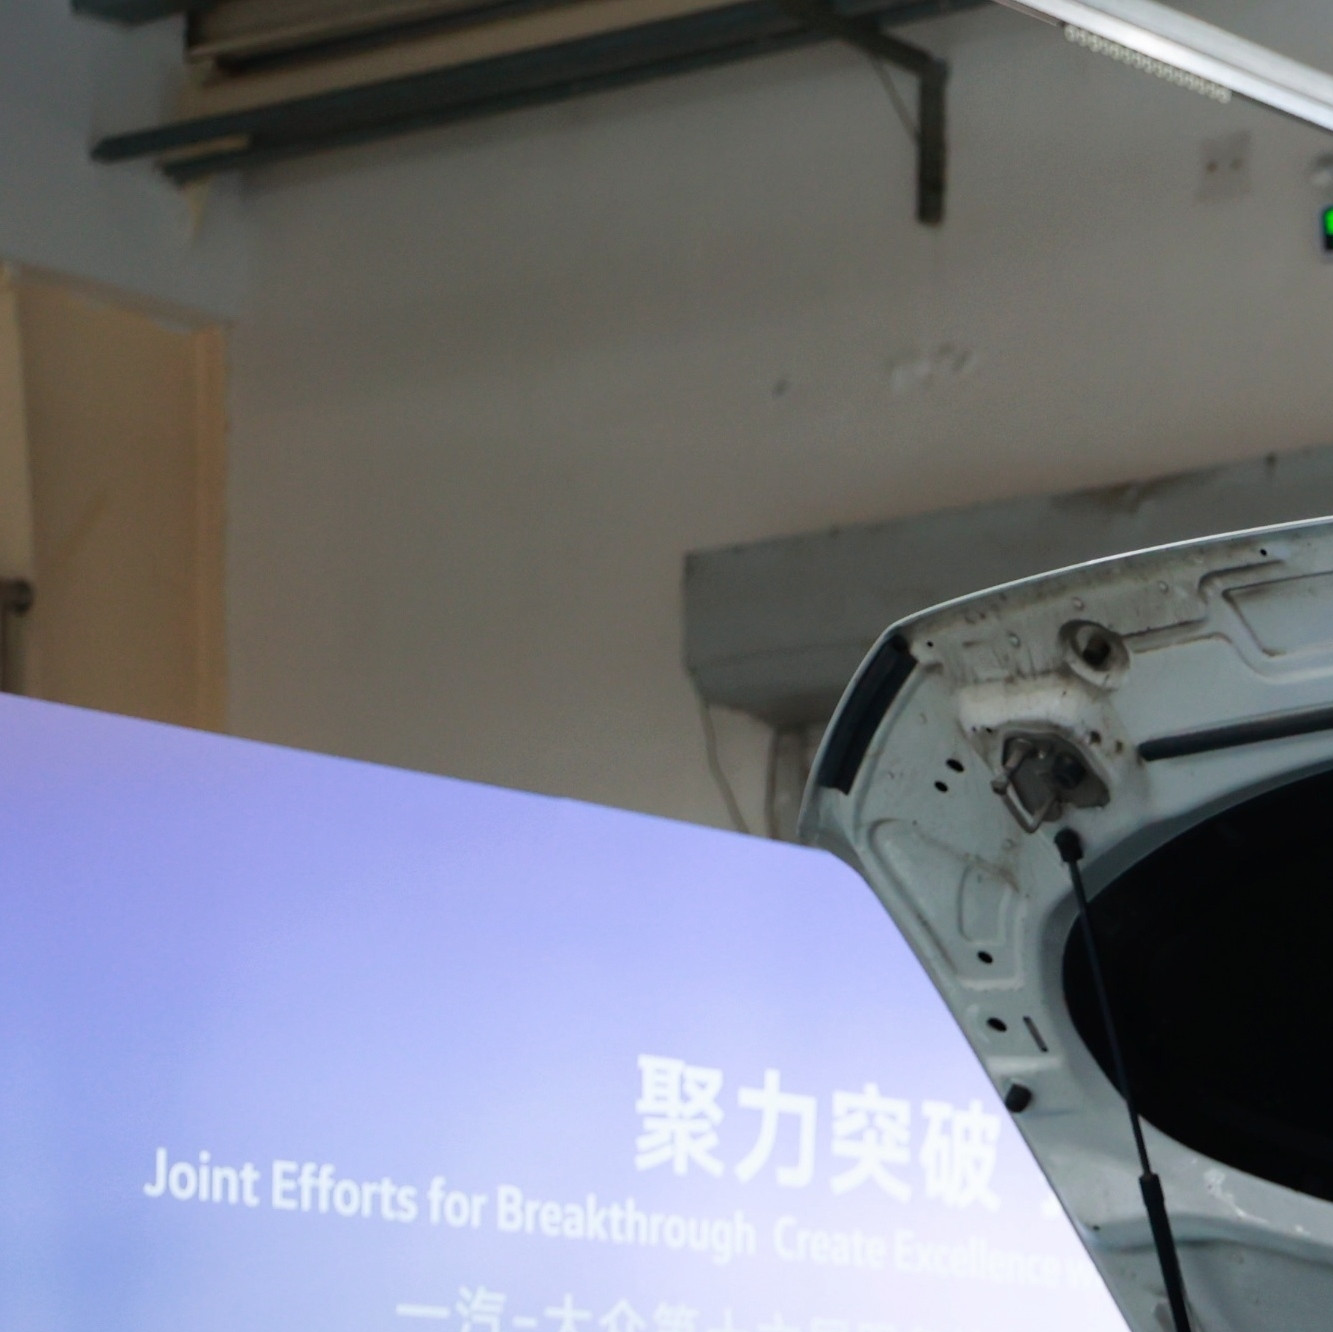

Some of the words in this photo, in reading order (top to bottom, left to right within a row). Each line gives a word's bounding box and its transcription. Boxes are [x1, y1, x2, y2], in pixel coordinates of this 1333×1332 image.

[634, 1054, 1001, 1213] 聚力突破
[143, 1146, 260, 1207] Joint
[271, 1160, 419, 1223] Efforts
[426, 1175, 488, 1229] for
[497, 1184, 757, 1266] Breakthrough
[773, 1214, 886, 1270] Create
[894, 1227, 1060, 1290] Excellence
